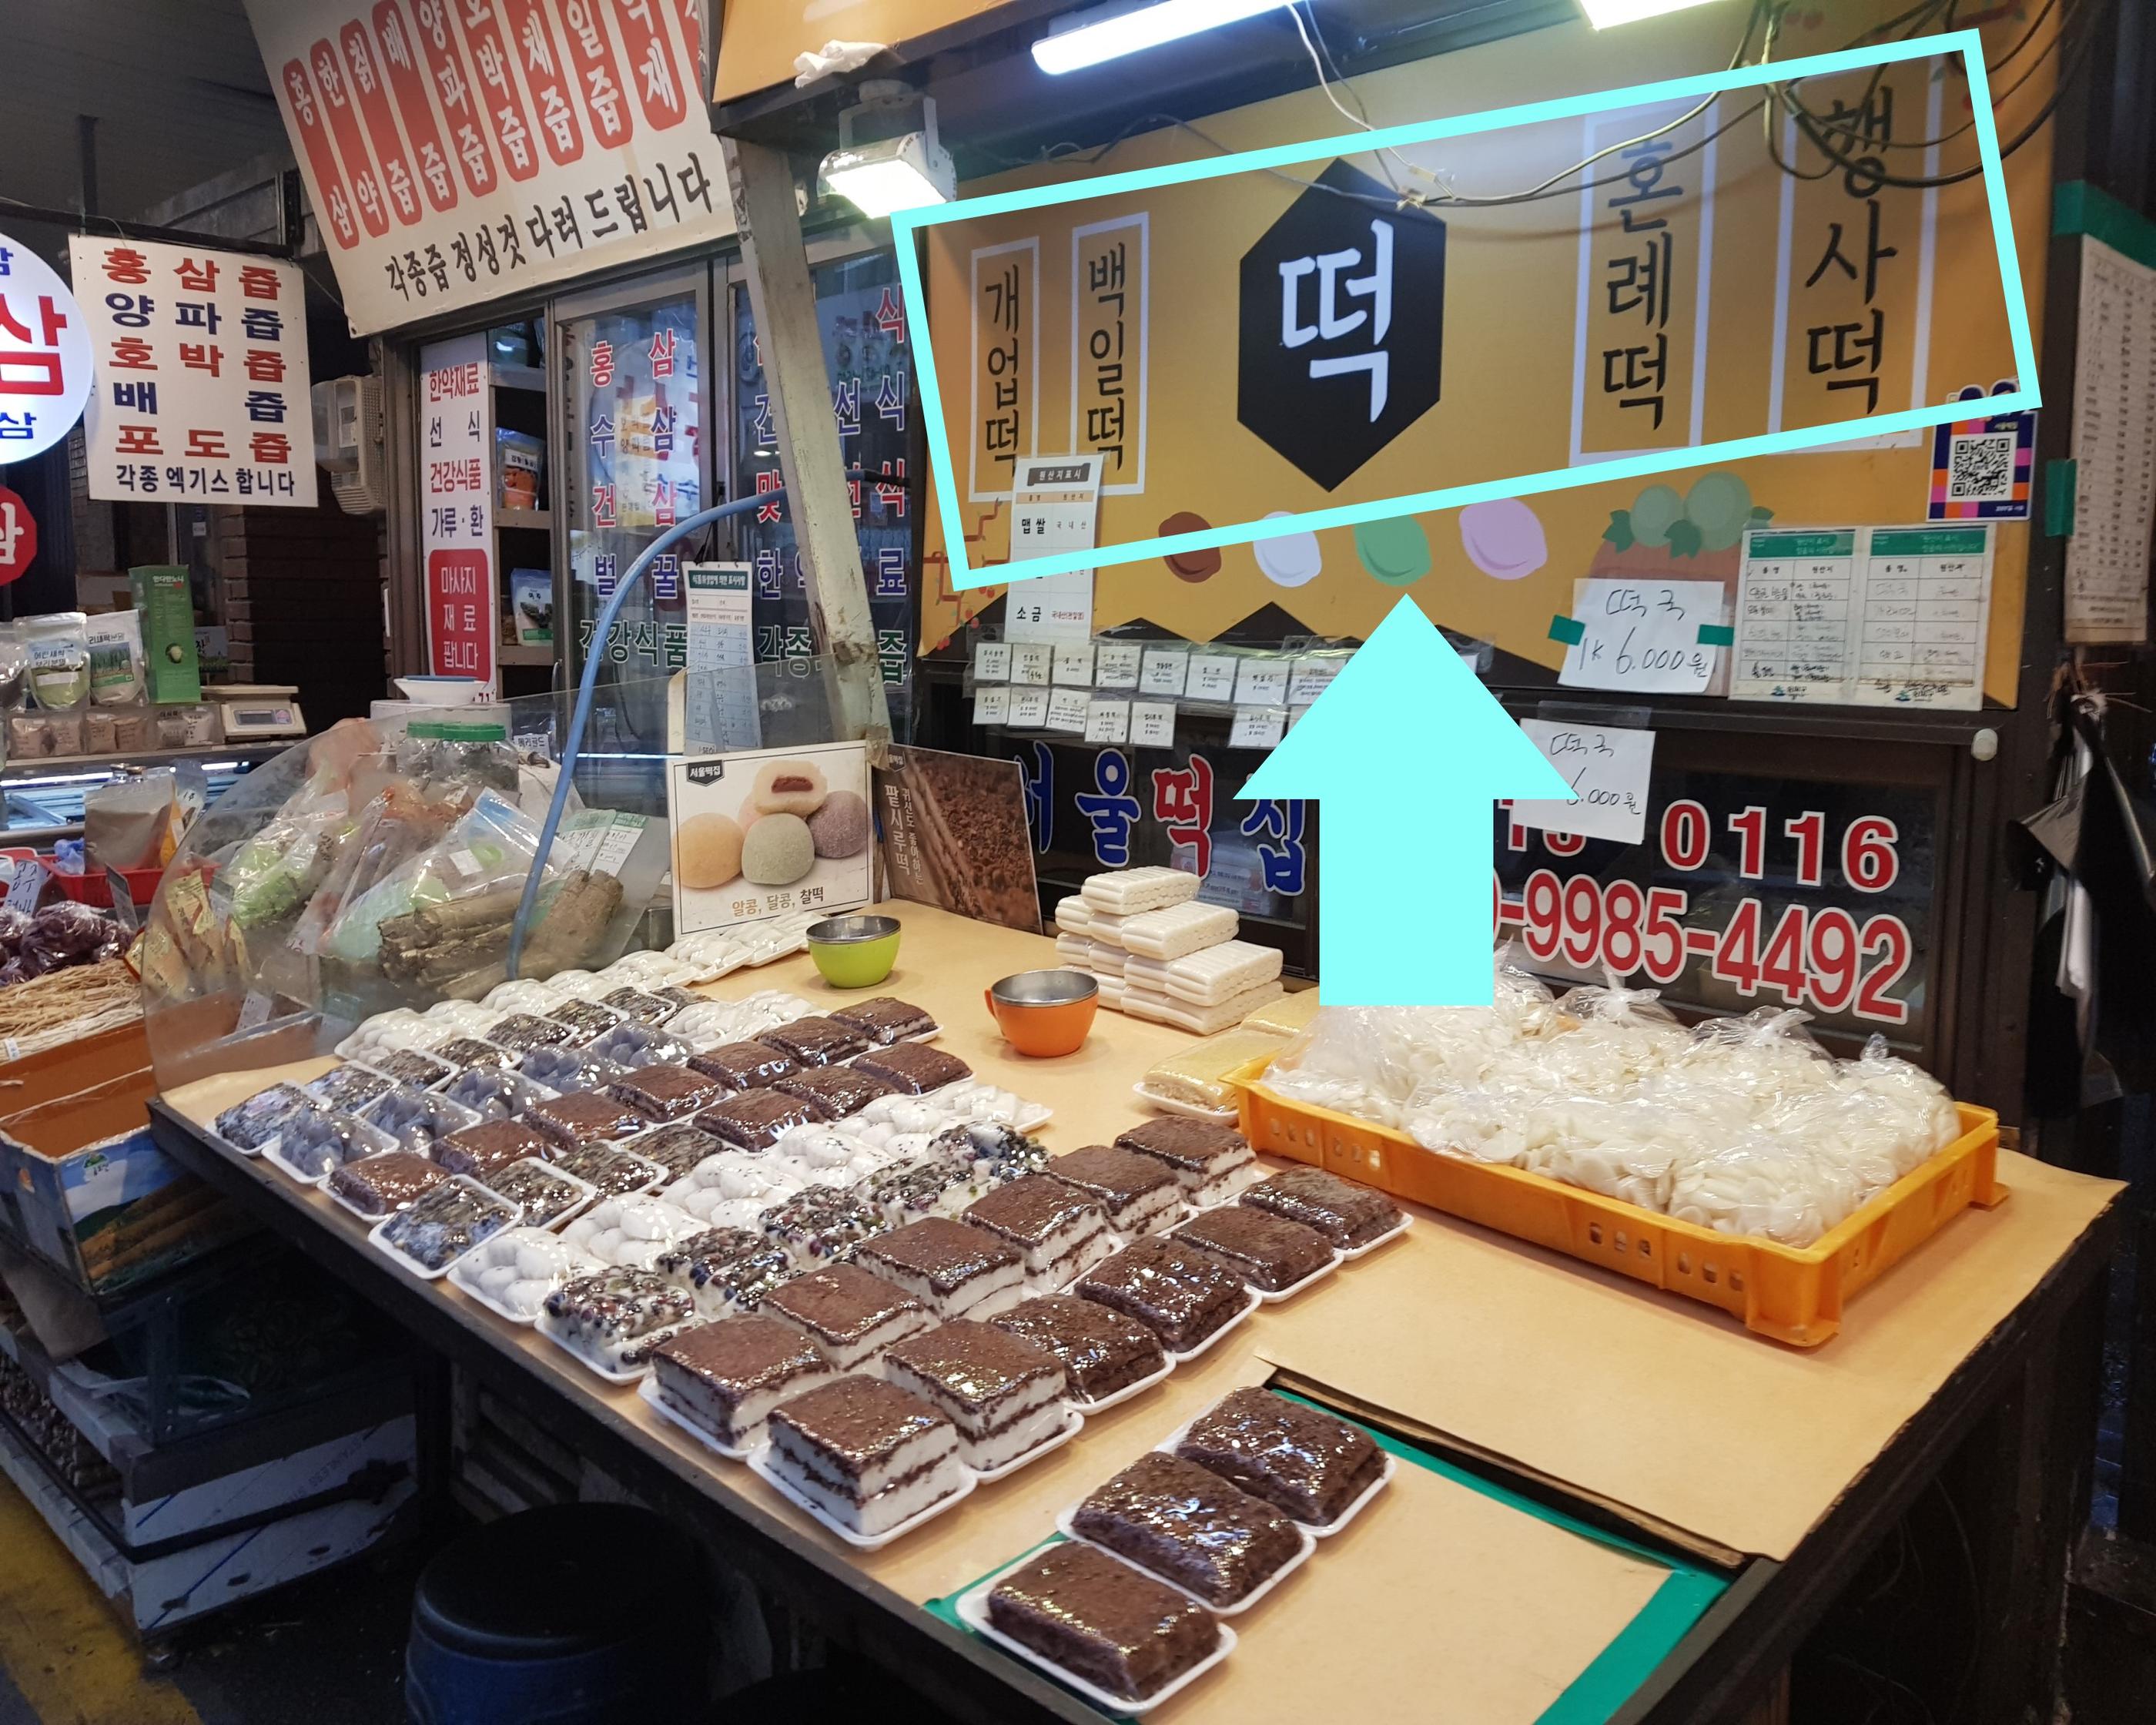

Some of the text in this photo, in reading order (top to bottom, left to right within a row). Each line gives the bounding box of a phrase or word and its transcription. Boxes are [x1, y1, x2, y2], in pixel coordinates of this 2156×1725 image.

[584, 151, 713, 239] 드립니다
[1601, 138, 1685, 431] 혼례떡
[1278, 218, 1394, 424] 떡
[985, 263, 1019, 478] 개업떡
[1086, 241, 1126, 471] 백일떡
[429, 361, 479, 403] 한약재료
[116, 464, 295, 497] 각종 엑기스 합니다
[430, 457, 481, 494] 건강식품
[431, 504, 484, 539] 가루 환
[440, 565, 476, 595] 마사지
[444, 639, 479, 671] 팝니다
[689, 765, 721, 779] 서울떡집
[884, 784, 910, 876] 팥시루떡
[732, 886, 825, 918] 알콩, 달콩, 찰떡
